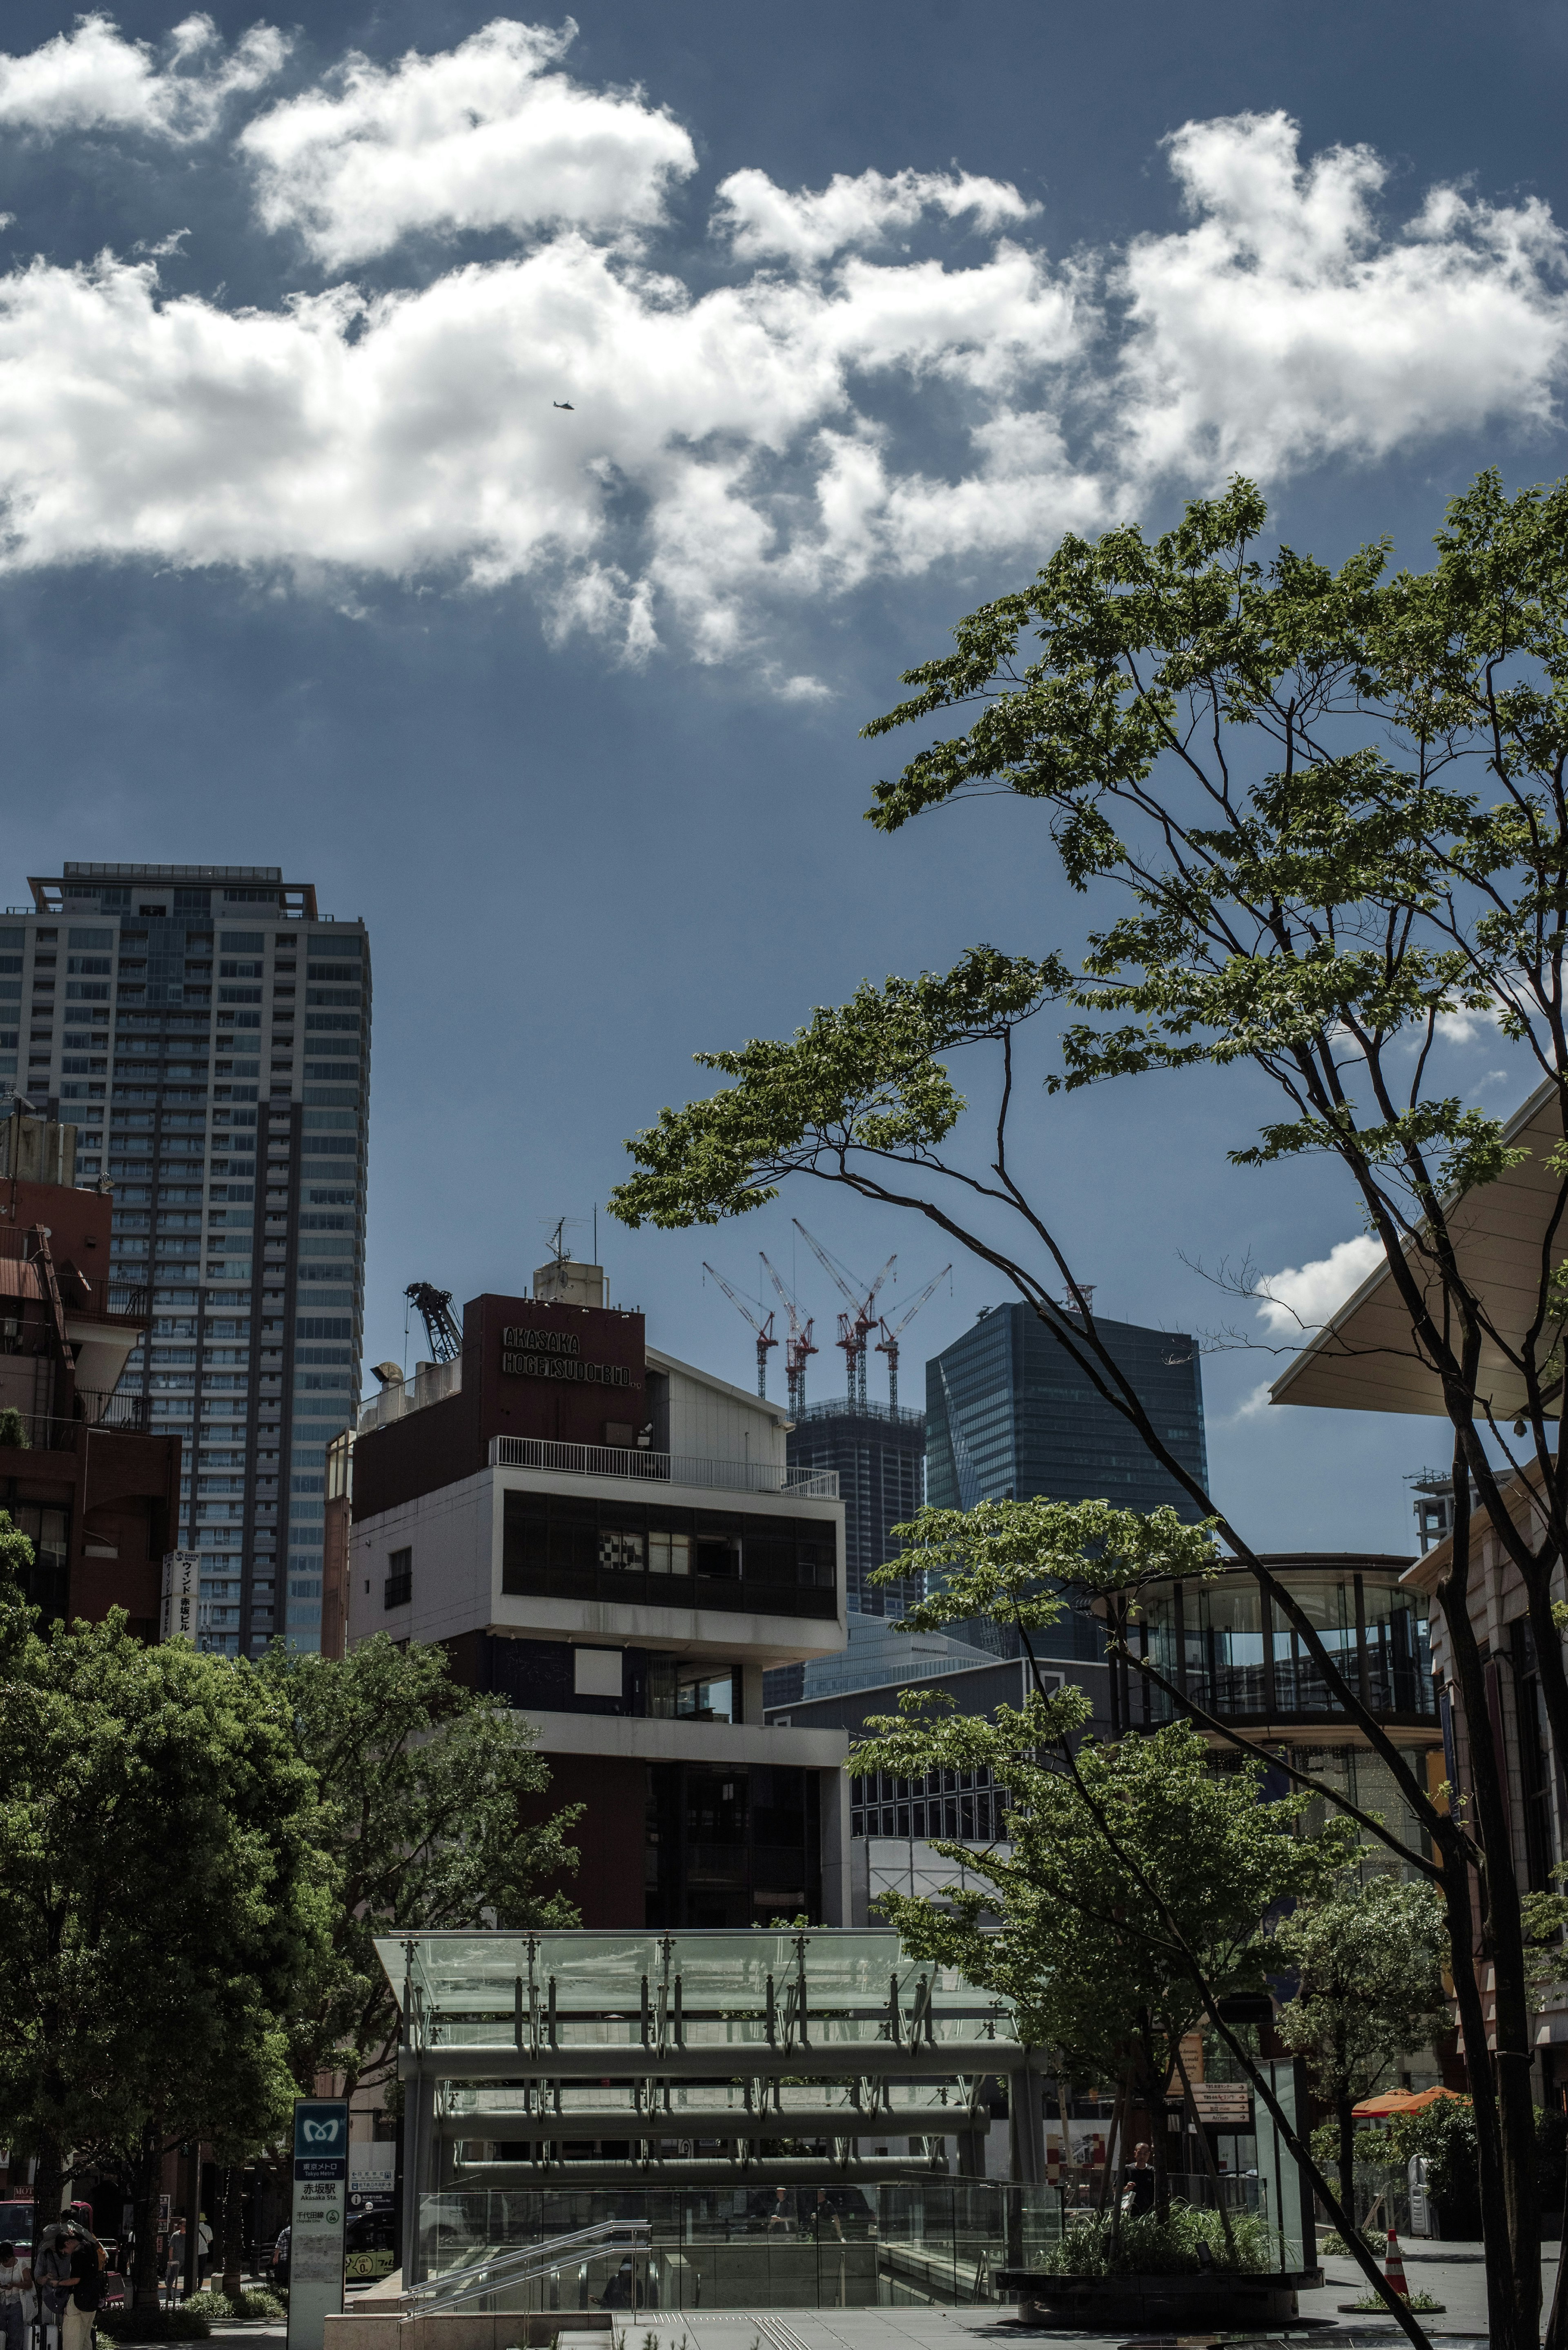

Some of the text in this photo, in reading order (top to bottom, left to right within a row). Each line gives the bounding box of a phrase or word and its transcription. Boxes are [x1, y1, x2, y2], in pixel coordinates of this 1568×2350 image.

[504, 1327, 580, 1354] AKASAKA
[503, 1353, 596, 1382] HOGETSUDO
[303, 2183, 335, 2194] 赤坂駅
